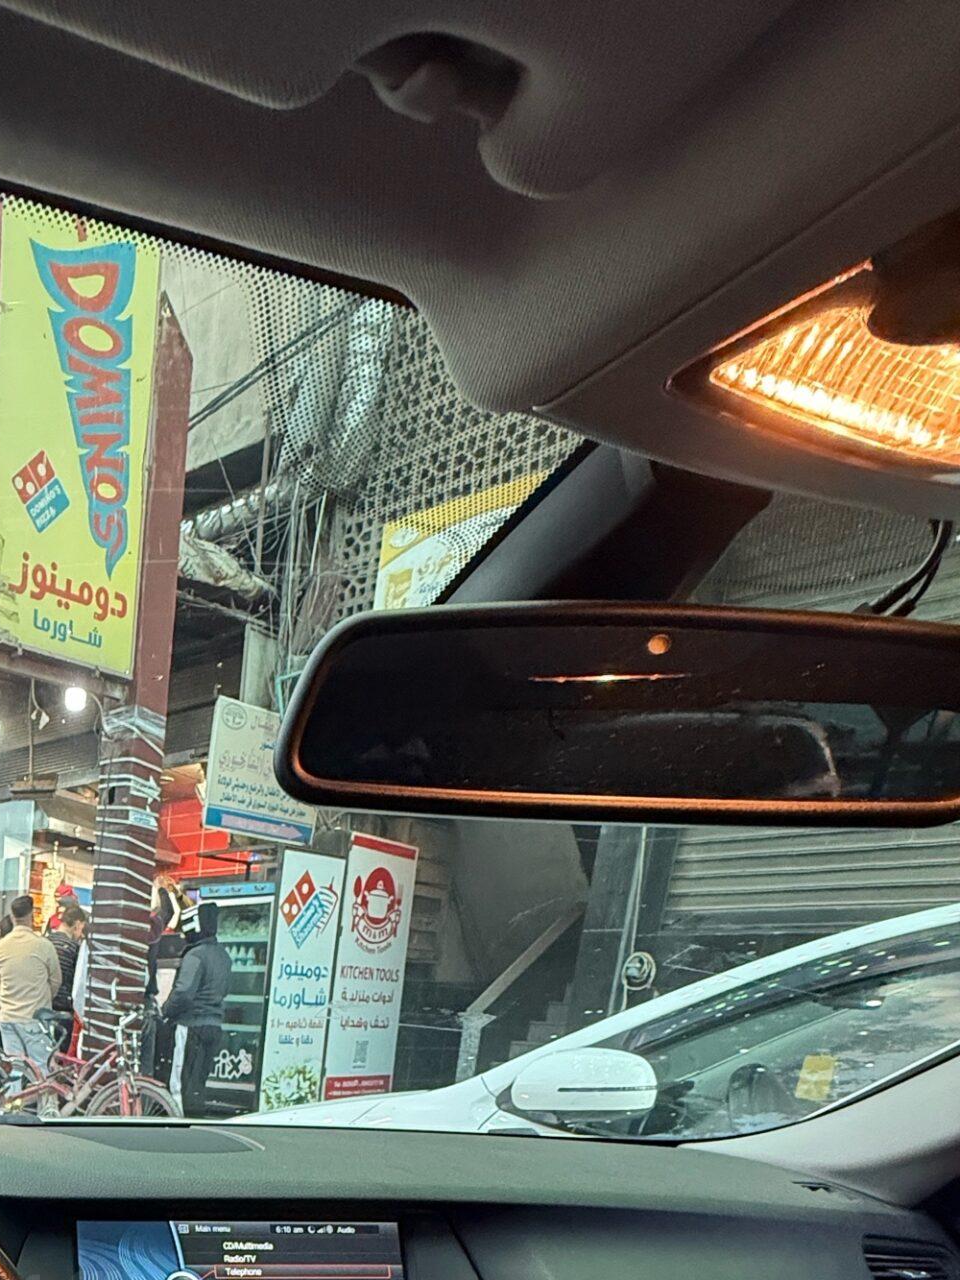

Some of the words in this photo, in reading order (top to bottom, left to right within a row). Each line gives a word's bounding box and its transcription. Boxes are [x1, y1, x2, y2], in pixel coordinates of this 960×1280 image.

[8, 552, 128, 621] دومينوز
[33, 608, 102, 648] شاورما
[278, 958, 329, 981] دومينوز
[340, 965, 373, 981] KITCHEN
[375, 967, 400, 982] TOOLS
[273, 987, 326, 1009] شاورما
[195, 1225, 210, 1233] Main
[223, 1242, 274, 1250] CD/Multimedia
[224, 1255, 256, 1263] Radio/TV
[225, 1268, 262, 1277] Telephone
